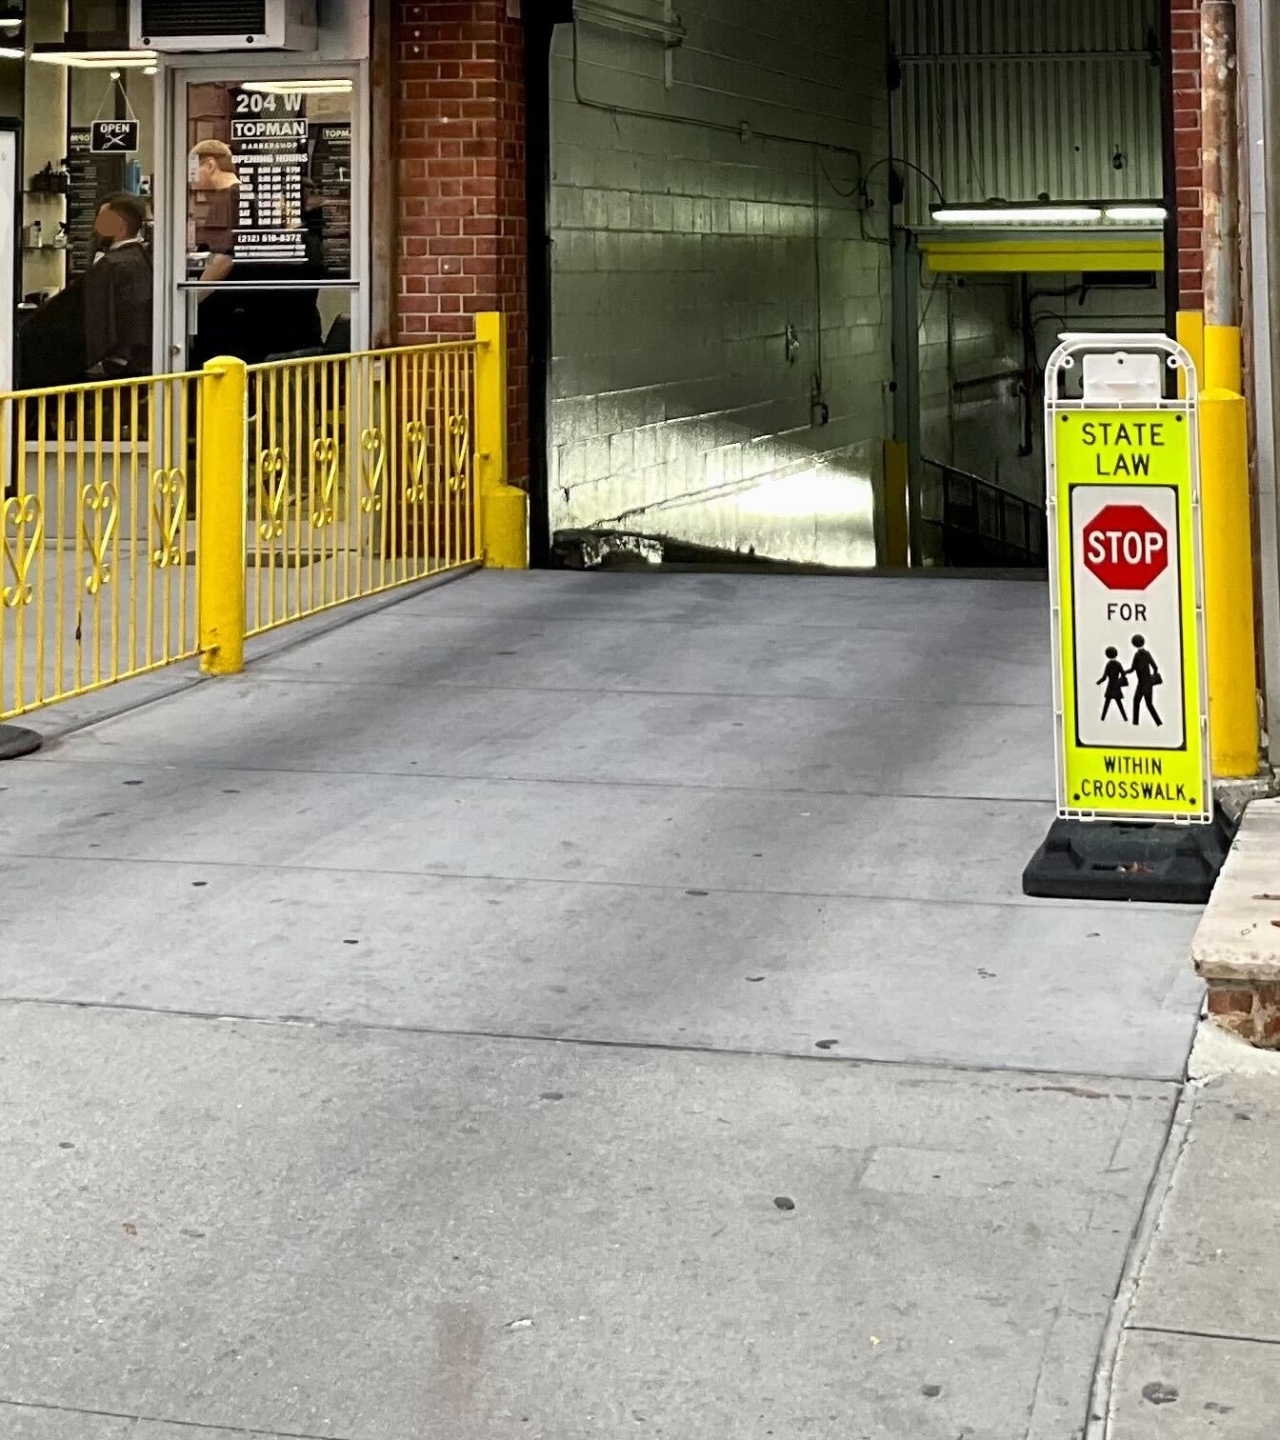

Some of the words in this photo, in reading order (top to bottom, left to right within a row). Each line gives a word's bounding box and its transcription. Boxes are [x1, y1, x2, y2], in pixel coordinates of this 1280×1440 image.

[236, 94, 276, 112] 204
[283, 93, 302, 111] W
[100, 122, 130, 133] OPEN
[235, 122, 304, 136] TOPMAN
[325, 129, 351, 138] TOPM
[231, 154, 273, 164] OPENING
[275, 153, 308, 163] HOURS
[237, 234, 260, 243] (212)
[1082, 422, 1165, 447] STATE
[1096, 453, 1151, 476] LAW
[1087, 530, 1164, 565] STOP
[1107, 602, 1147, 622] FOR
[1103, 757, 1162, 776] WITHIN
[1081, 778, 1187, 802] CROSSWALK
